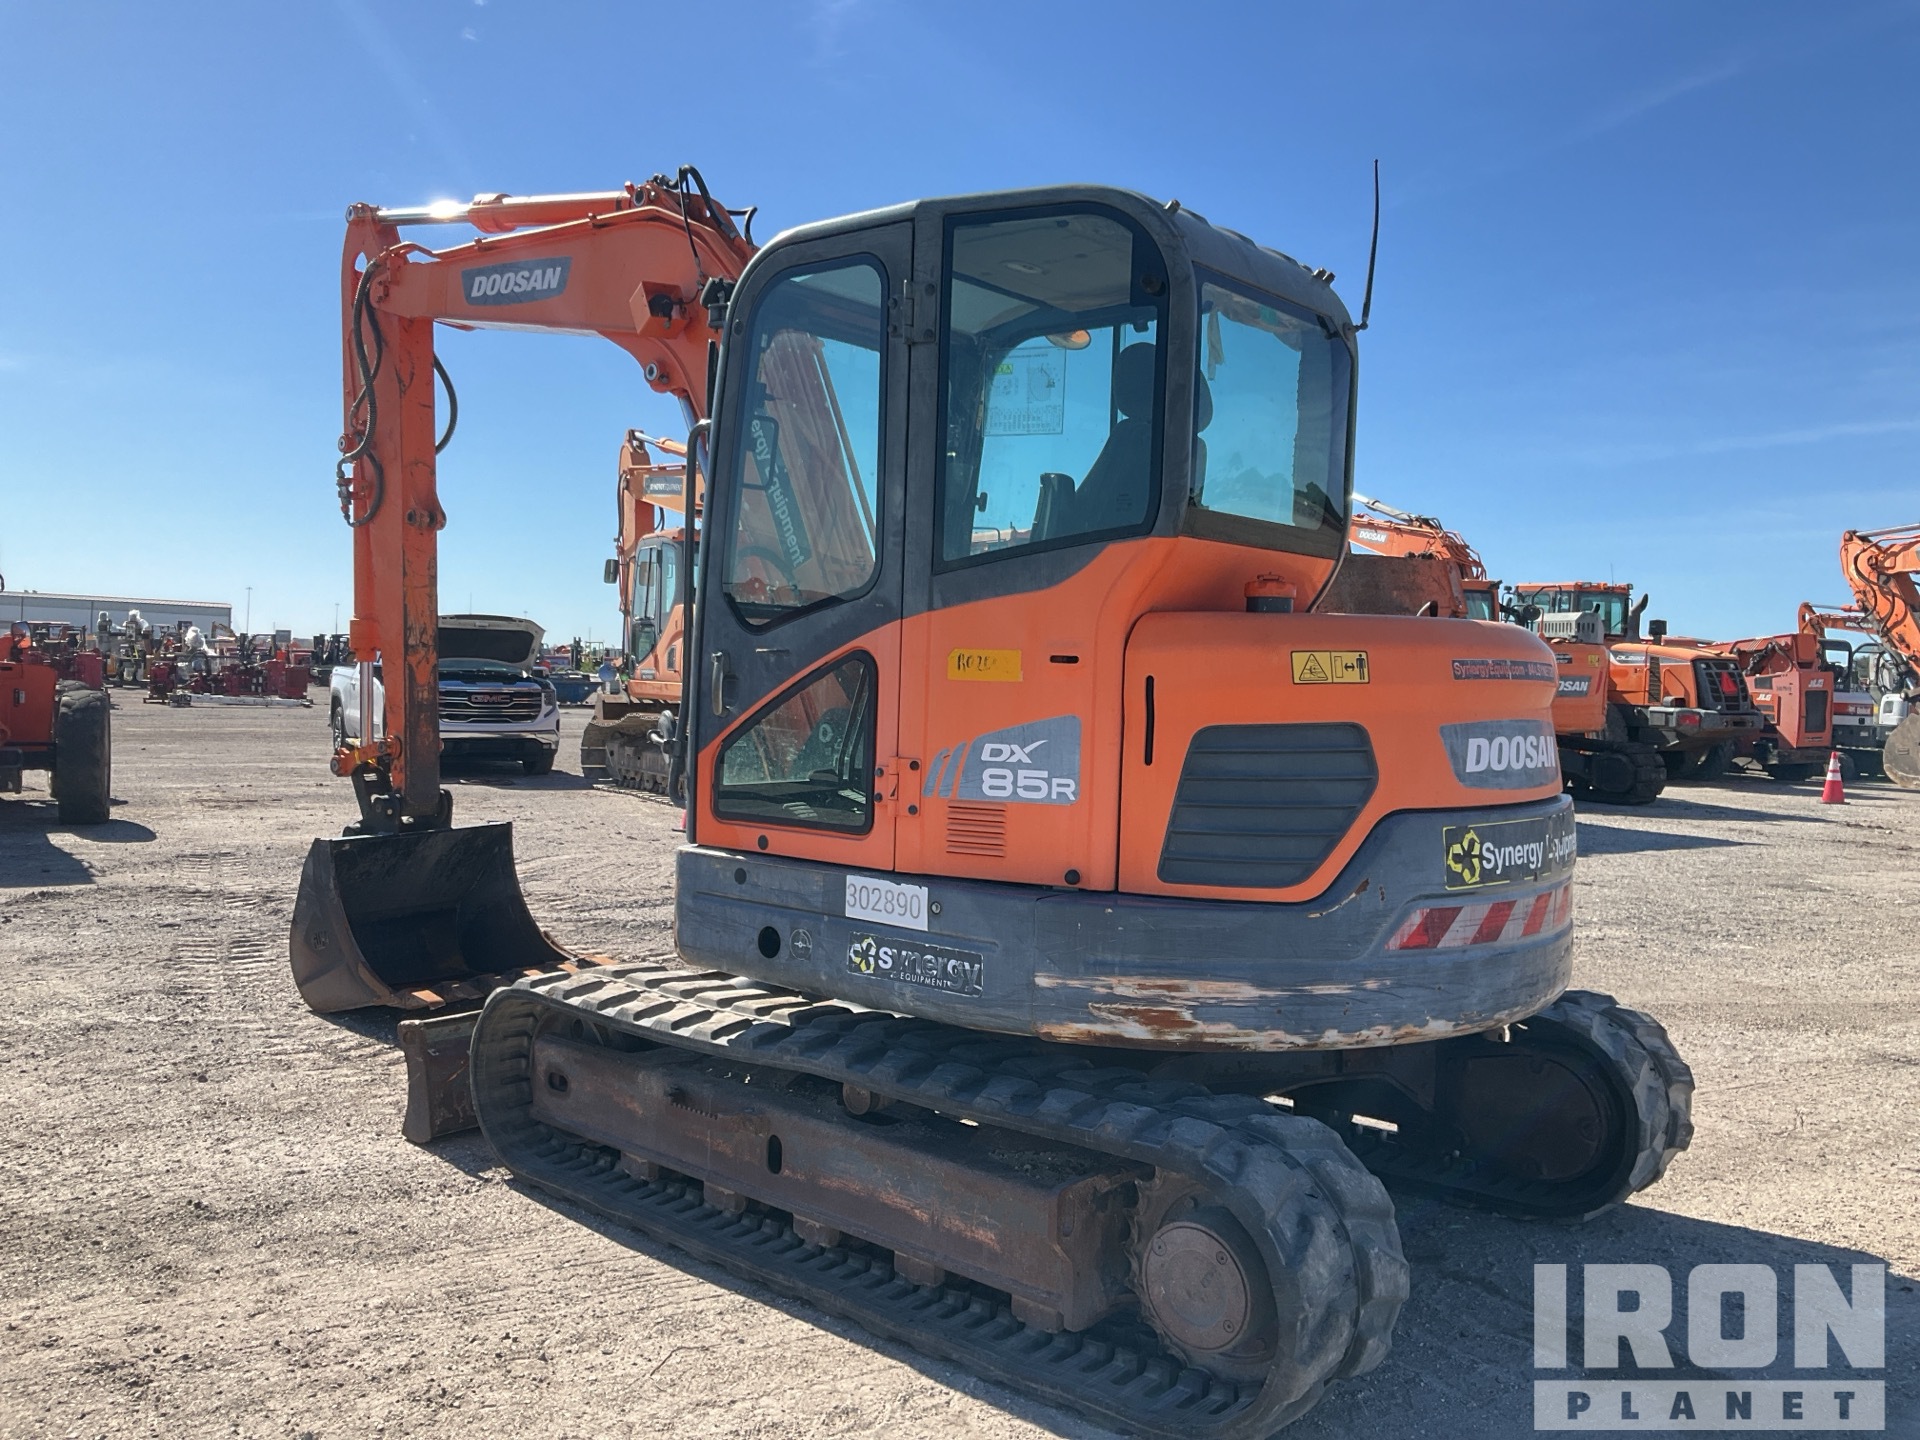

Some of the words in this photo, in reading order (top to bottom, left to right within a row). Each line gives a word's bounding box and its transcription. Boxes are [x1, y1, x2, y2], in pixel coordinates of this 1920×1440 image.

[471, 267, 562, 298] DOOSAN
[752, 419, 771, 462] ergy
[1359, 530, 1388, 543] DOOSAN
[471, 694, 510, 702] GMC
[1558, 680, 1589, 691] OSAN
[1756, 693, 1772, 701] JLG
[981, 740, 1048, 764] DX
[1466, 735, 1556, 773] DOOSAN
[982, 768, 1076, 800] 85R
[1482, 842, 1544, 875] Synergy
[847, 883, 921, 919] 302890
[900, 972, 950, 988] EQUIPMENT
